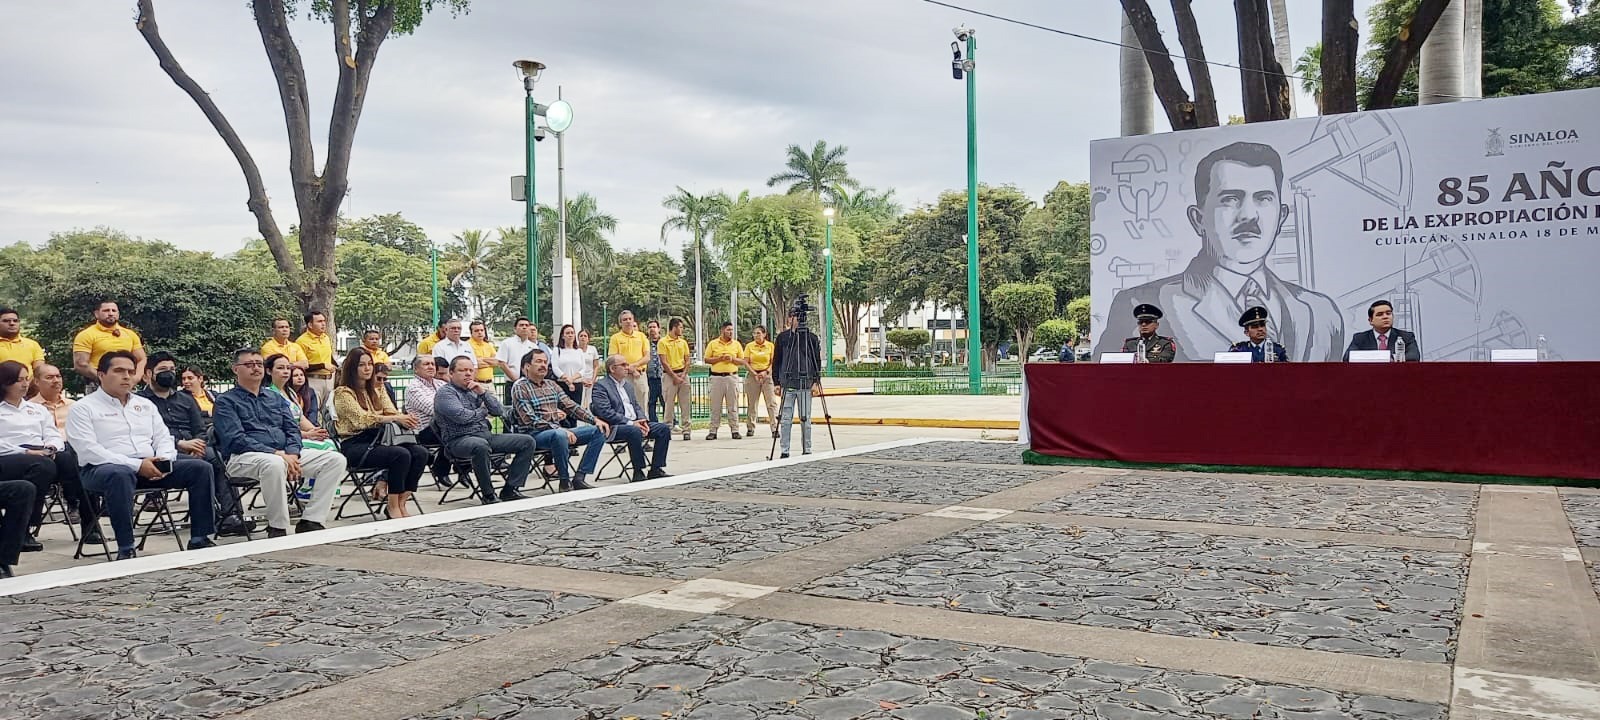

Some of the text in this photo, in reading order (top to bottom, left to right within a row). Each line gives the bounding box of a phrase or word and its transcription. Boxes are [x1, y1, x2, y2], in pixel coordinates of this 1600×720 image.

[1509, 129, 1579, 145] SINALOA
[1437, 175, 1490, 207] 85
[1362, 217, 1389, 232] DE
[1393, 216, 1420, 230] LA
[1424, 202, 1588, 229] EXPROPIACIÓN
[1375, 233, 1454, 246] CULIACÁN,
[1462, 229, 1528, 242] SINALOA
[1536, 229, 1551, 238] 18
[1559, 227, 1578, 237] DE
